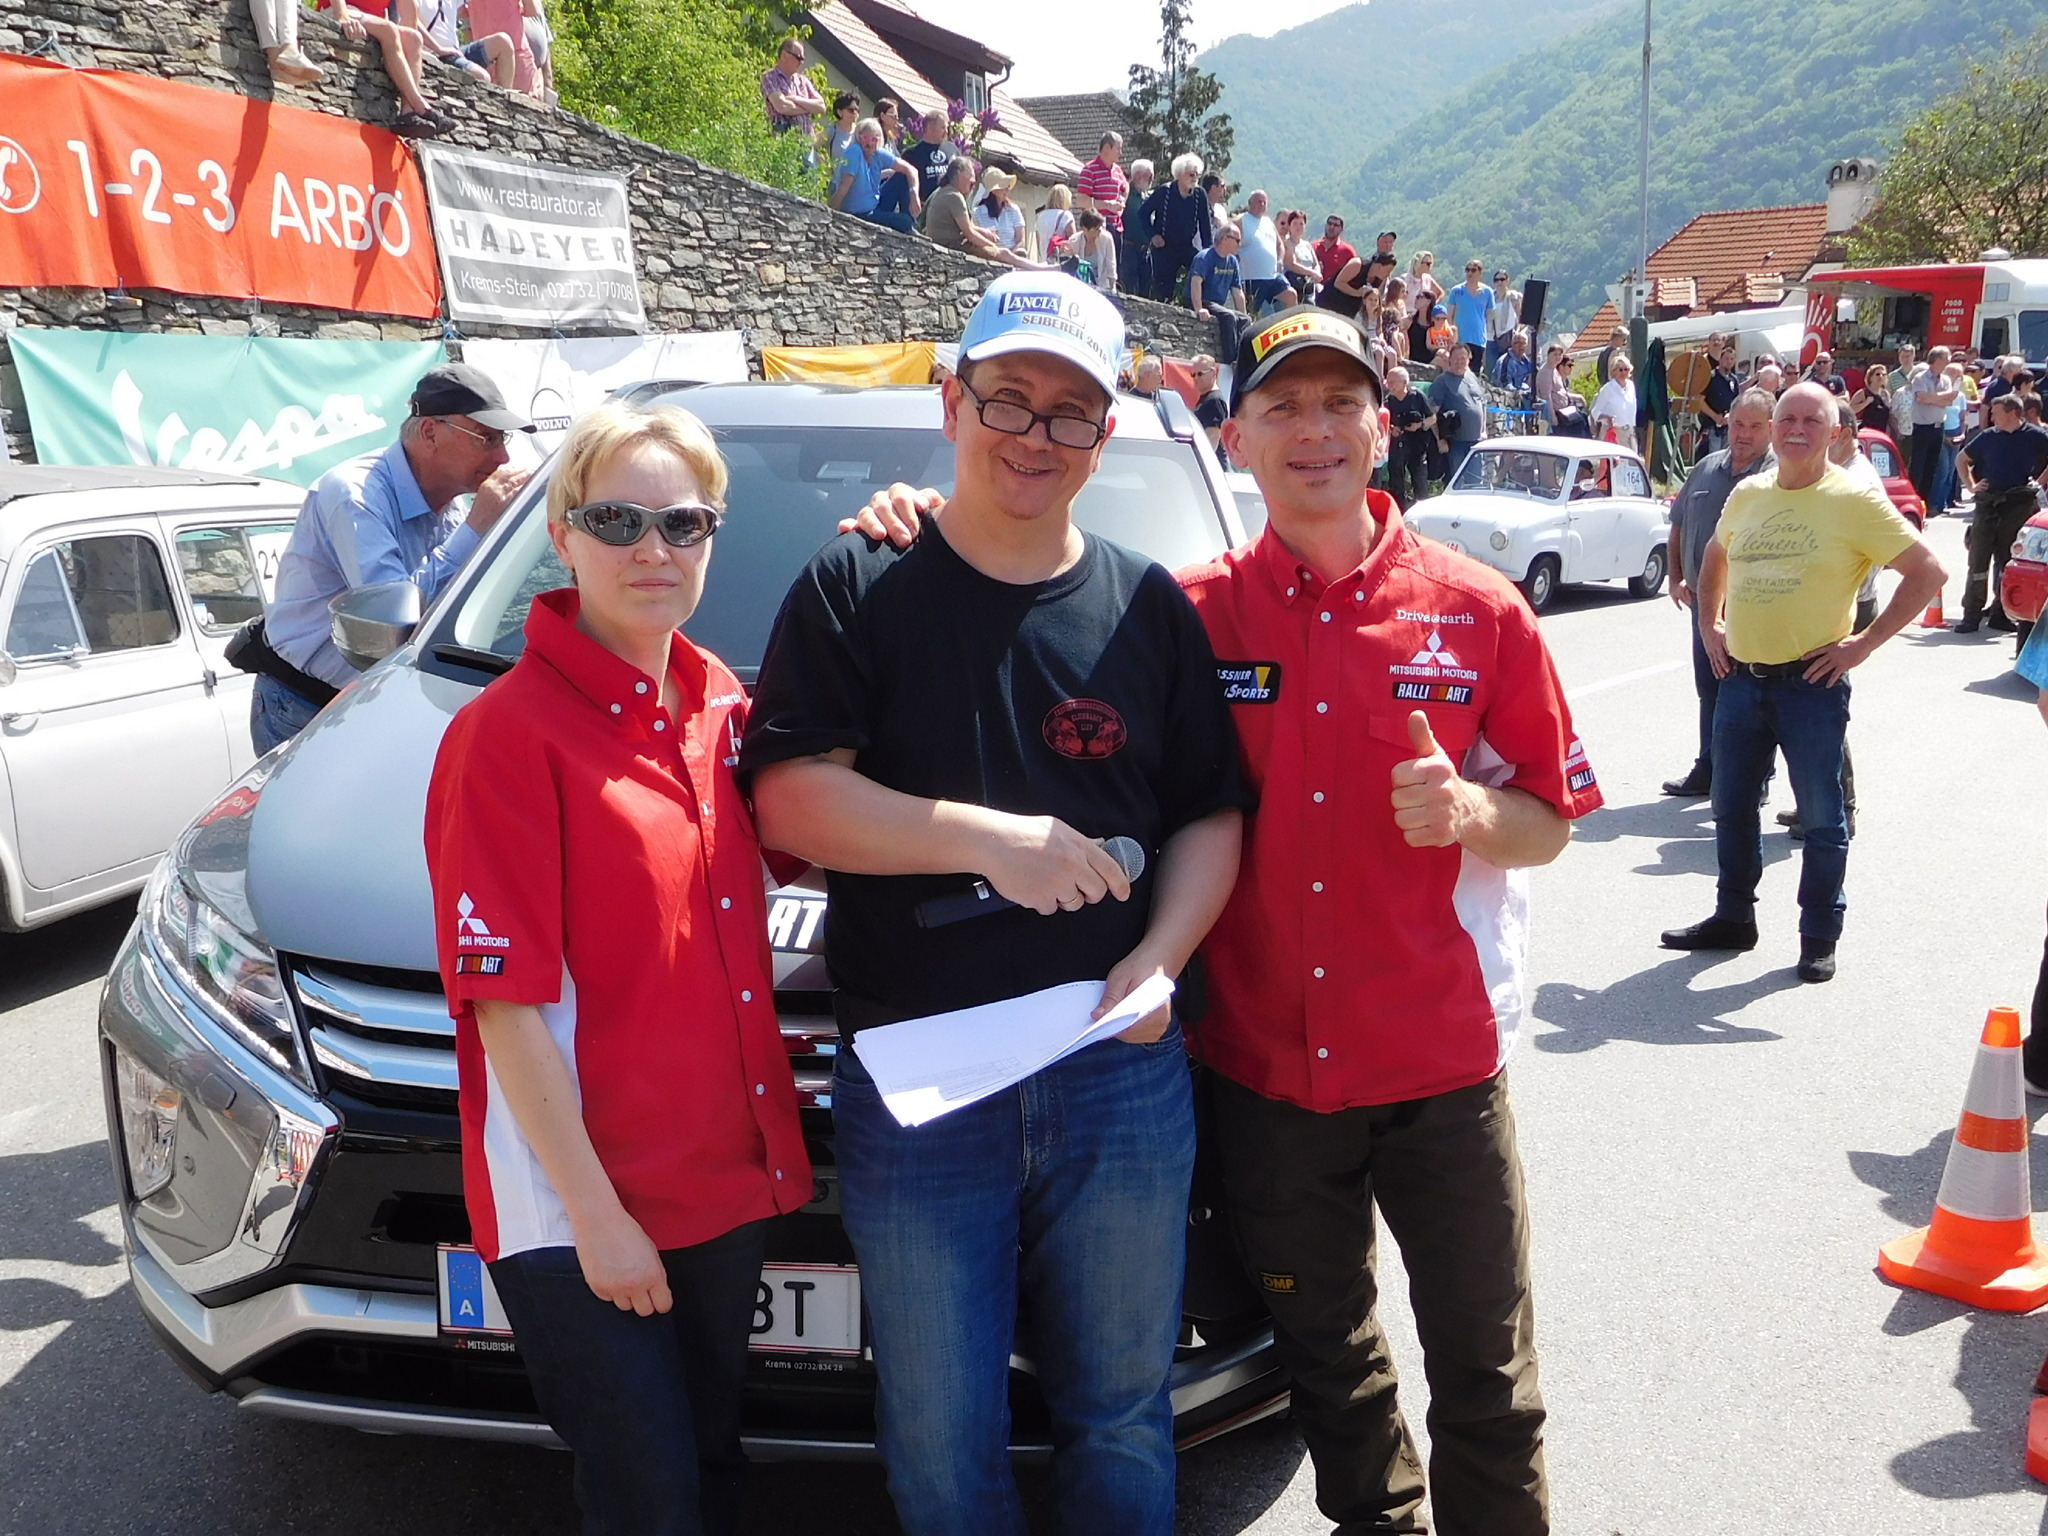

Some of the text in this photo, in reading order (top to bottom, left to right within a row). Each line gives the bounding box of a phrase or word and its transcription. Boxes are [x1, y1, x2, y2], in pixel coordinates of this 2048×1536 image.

[67, 139, 411, 257] 1-2-3 ARBÖ
[457, 179, 605, 218] www.restaurator.at
[450, 218, 628, 264] HADEYER
[1002, 292, 1060, 315] LANCIA
[1021, 314, 1085, 341] SEIBERER
[533, 418, 571, 431] VOLVO
[1395, 609, 1475, 625] Drive@earth
[1389, 664, 1478, 681] MITSUBISHI MOTORS
[1570, 768, 1595, 791] RALLI
[474, 936, 510, 948] MOTORS
[1262, 1276, 1295, 1290] OMP
[459, 1298, 475, 1317] A
[466, 1340, 516, 1353] MITSUBISHI
[765, 1359, 792, 1370] Krems
